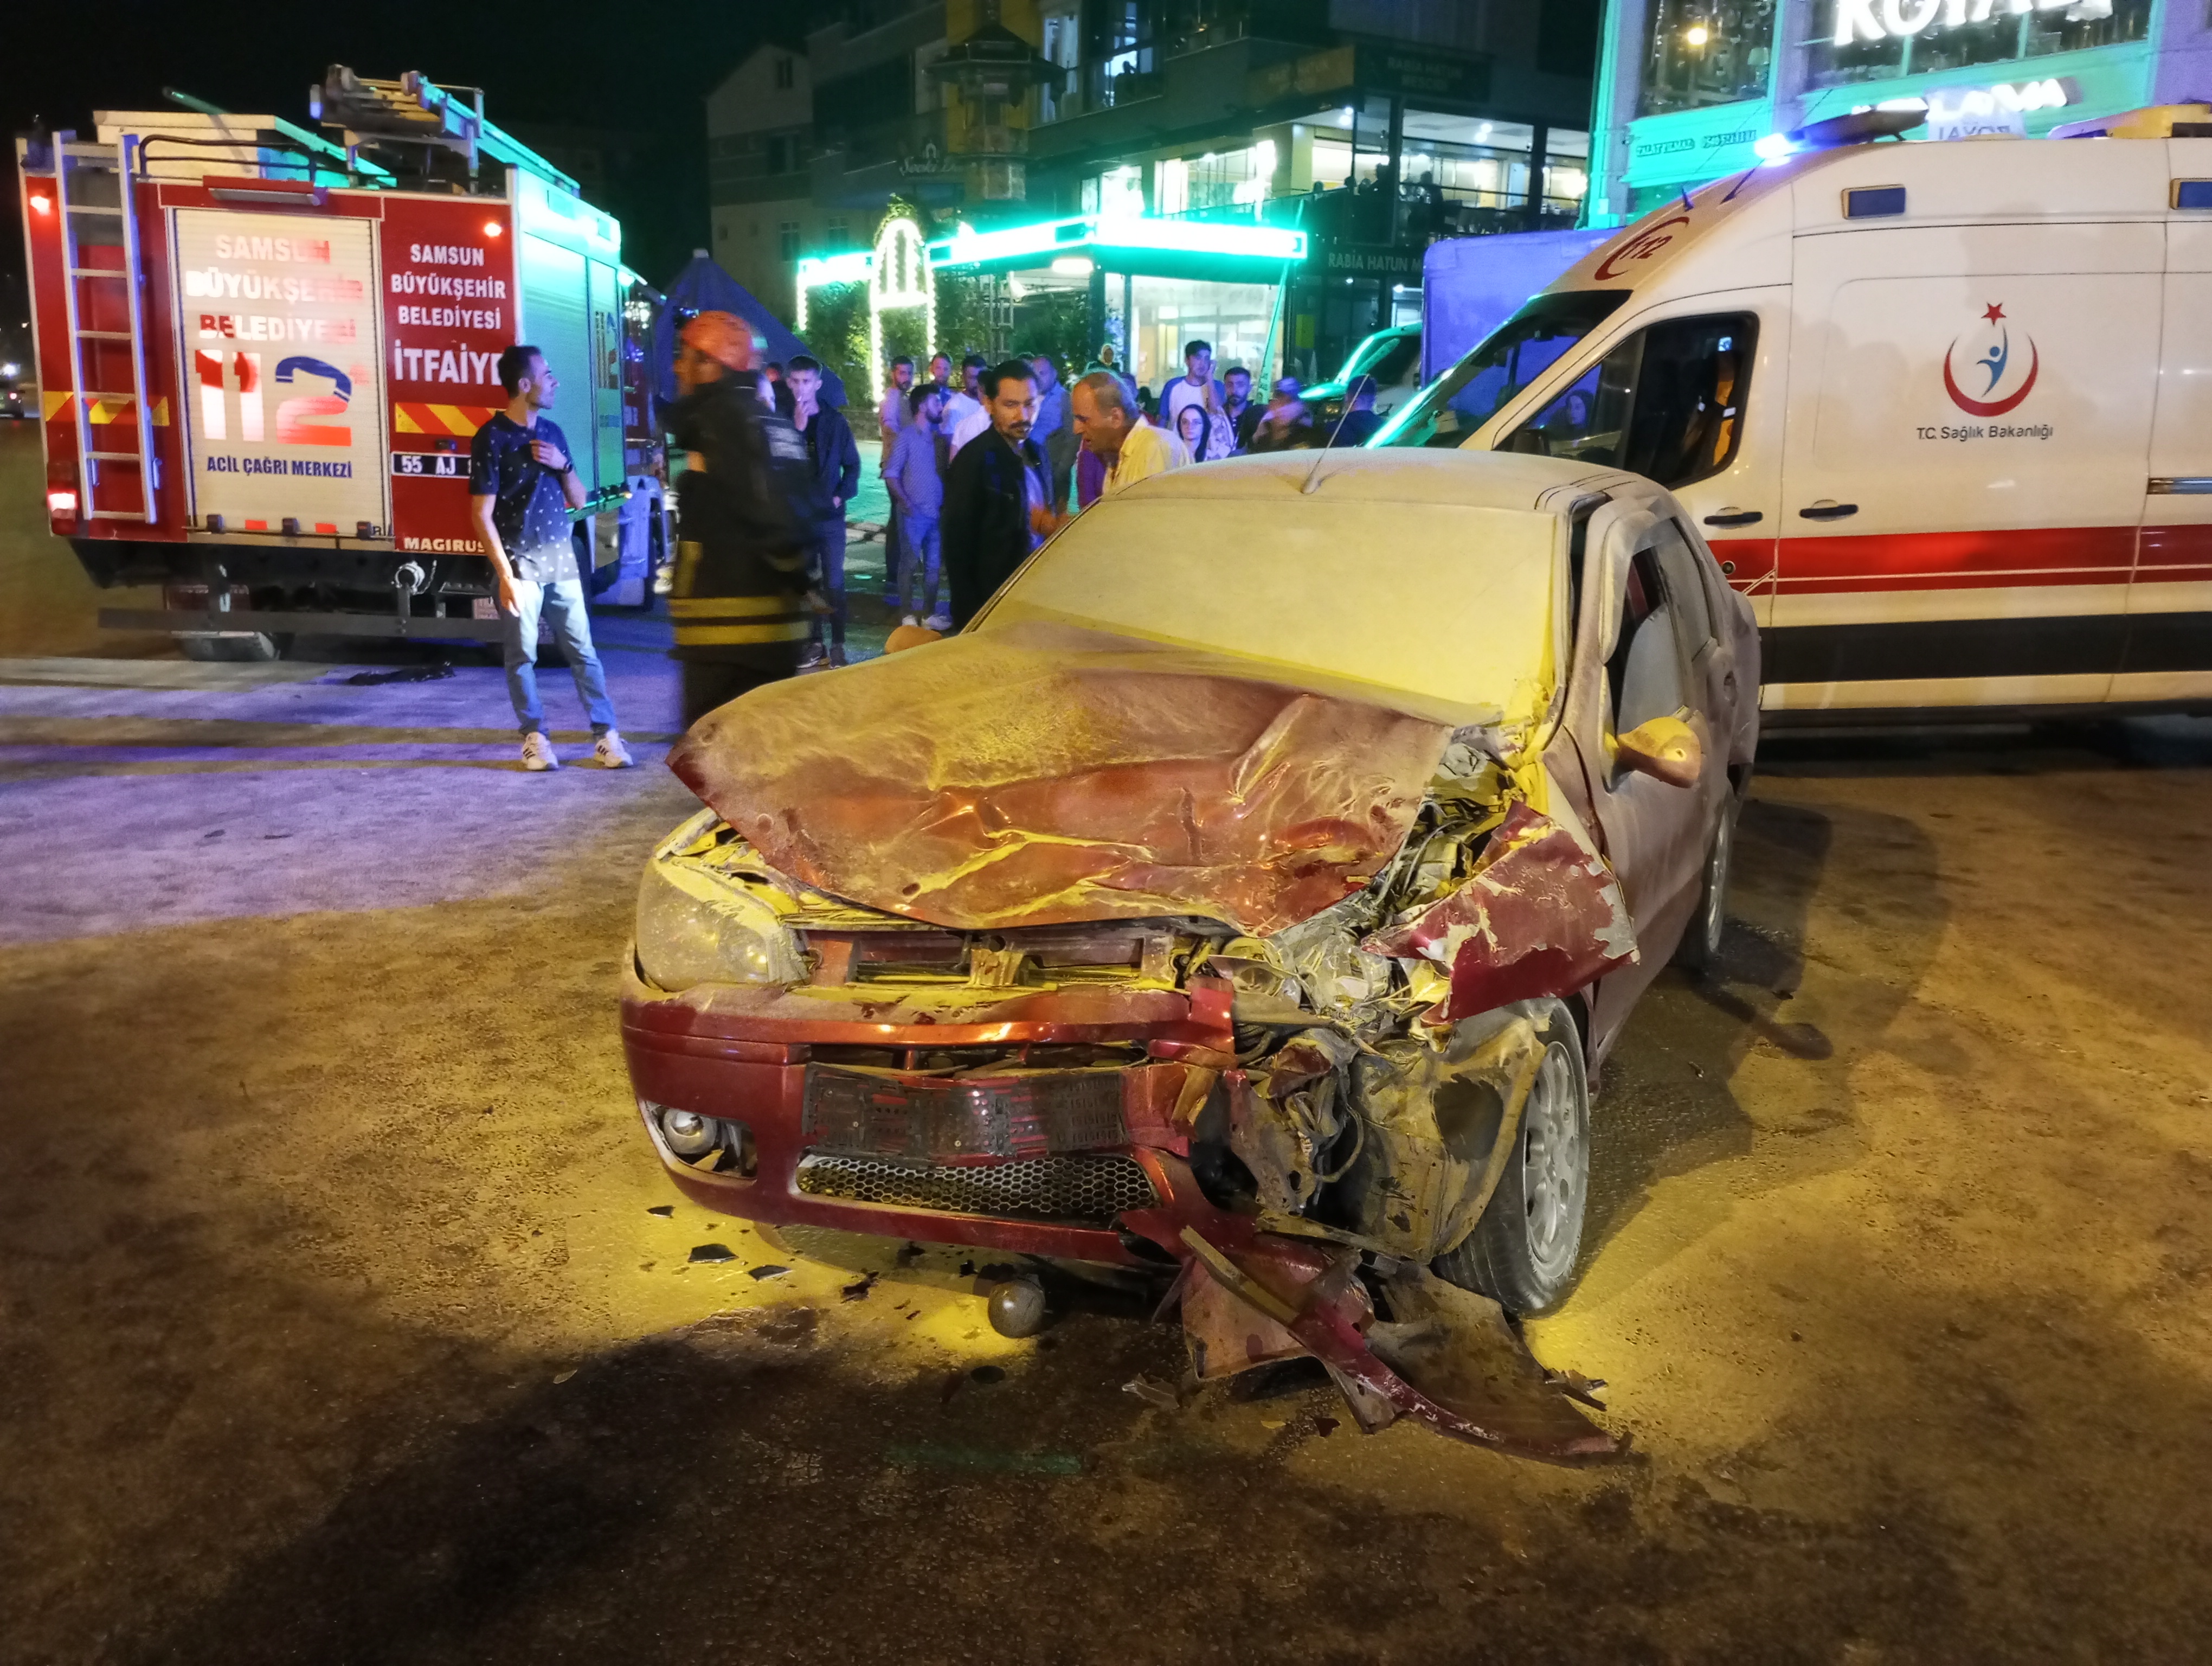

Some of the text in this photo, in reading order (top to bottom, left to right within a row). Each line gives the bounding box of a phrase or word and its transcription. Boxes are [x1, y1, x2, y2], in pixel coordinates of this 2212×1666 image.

[410, 244, 485, 266] SAMSUN
[1619, 235, 1673, 260] 112
[1328, 249, 1363, 270] RABİA
[1367, 255, 1408, 271] HATUN
[391, 271, 506, 301] BÜYÜKŞEHİR
[398, 304, 501, 330] BELEDİYESİ
[195, 349, 352, 446] 112
[1941, 426, 1984, 441] Sağlık
[1988, 424, 2053, 440] Bakanlığı
[207, 454, 352, 478] ACİL ÇAĞRI MERKEZİ
[401, 455, 423, 473] 55
[435, 456, 456, 475] AJ
